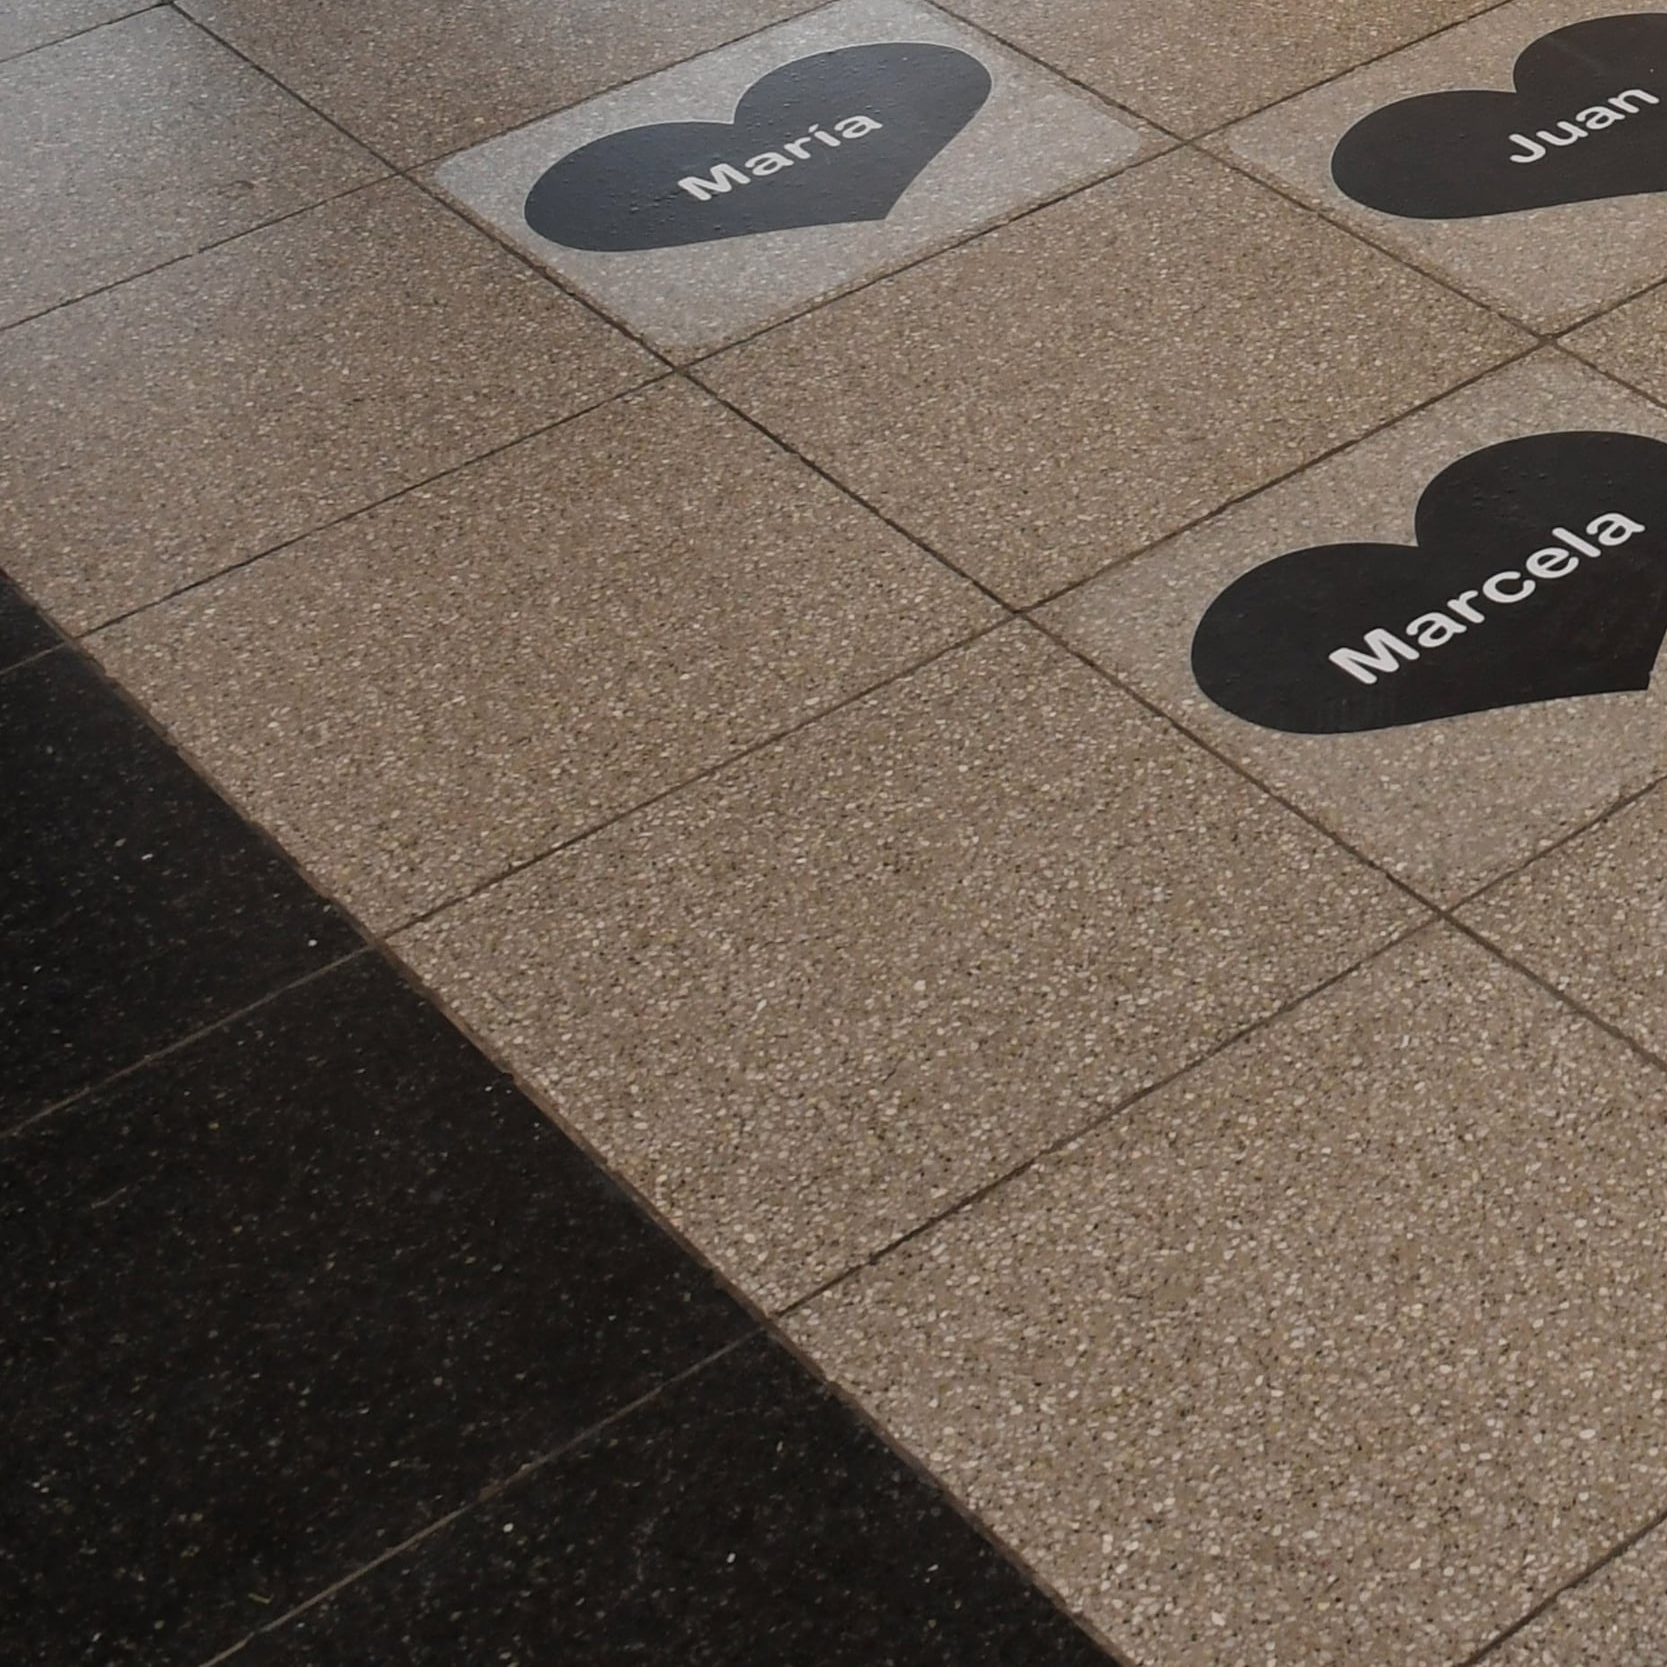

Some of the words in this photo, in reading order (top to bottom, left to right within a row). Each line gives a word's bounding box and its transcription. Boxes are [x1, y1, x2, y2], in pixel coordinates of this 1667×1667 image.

[676, 109, 884, 202] María
[1503, 81, 1661, 165] Juan
[1326, 504, 1648, 687] Marcela
